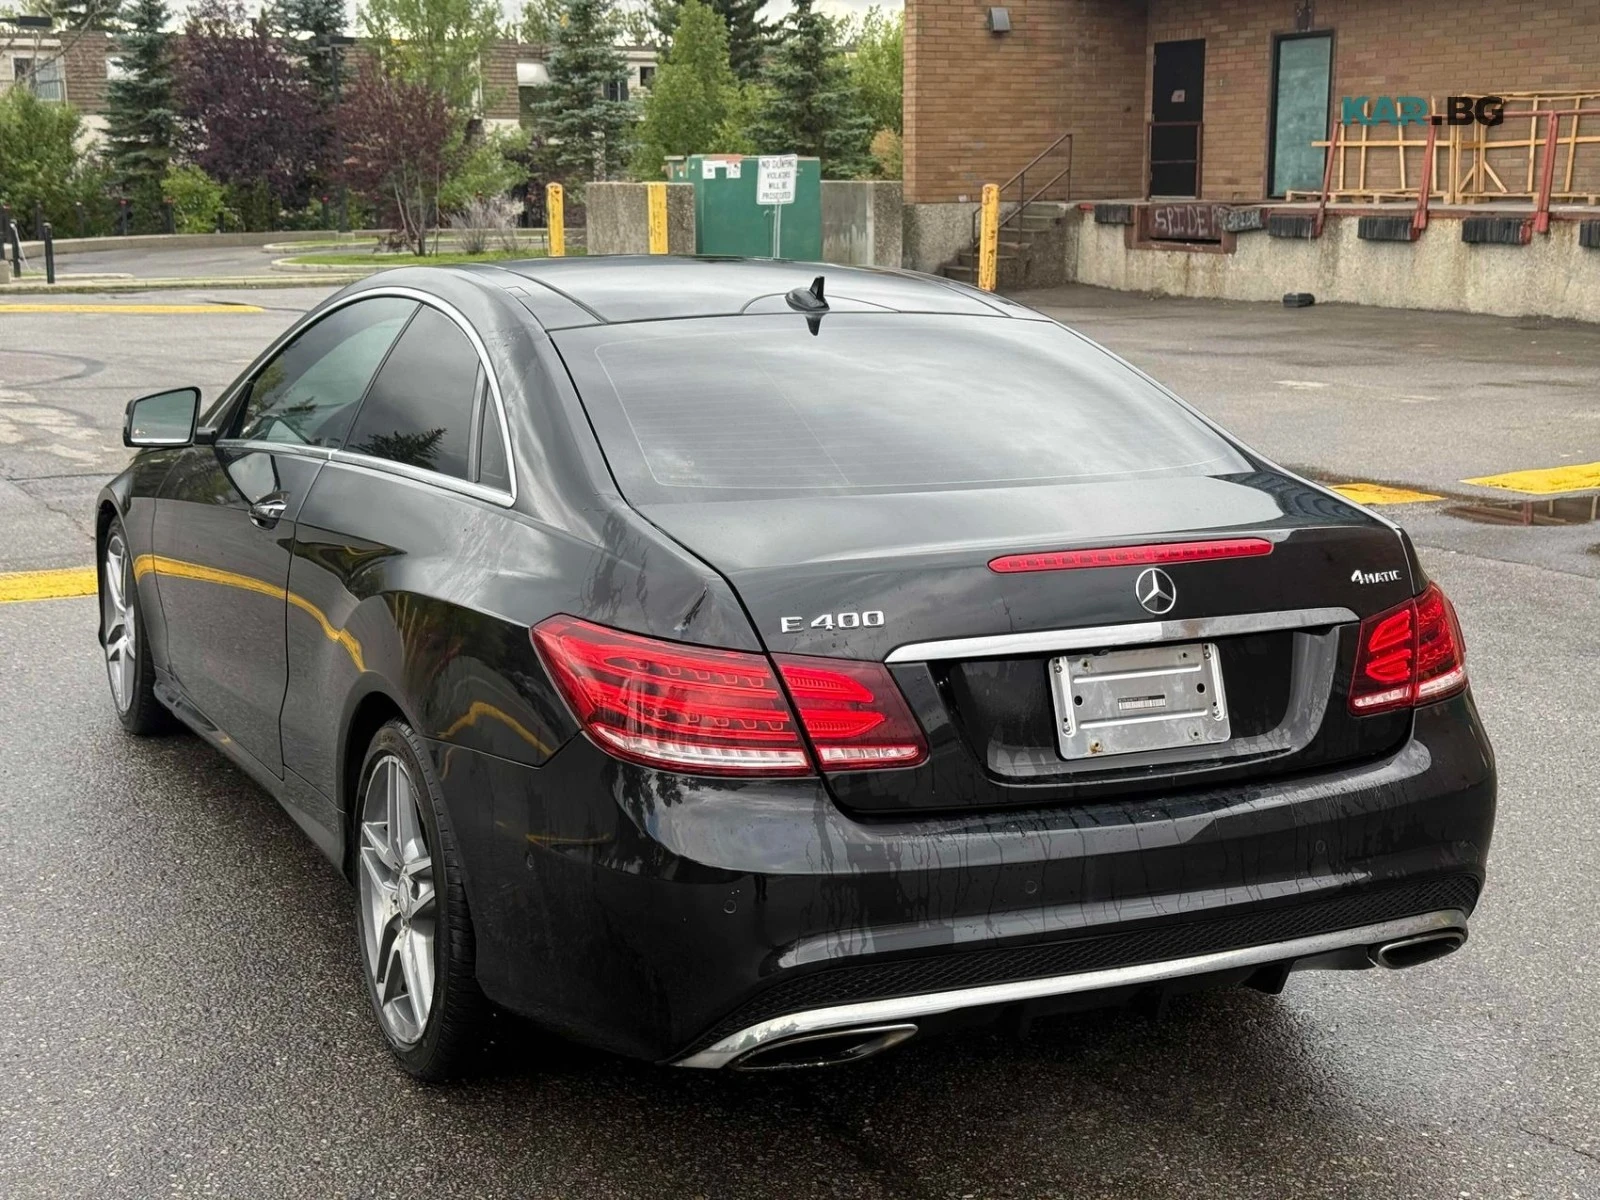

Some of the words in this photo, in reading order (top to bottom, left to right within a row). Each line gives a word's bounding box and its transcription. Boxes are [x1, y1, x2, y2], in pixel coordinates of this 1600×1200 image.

[1351, 569, 1402, 585] 4MATIC
[780, 616, 804, 634] E
[810, 610, 885, 631] 400
